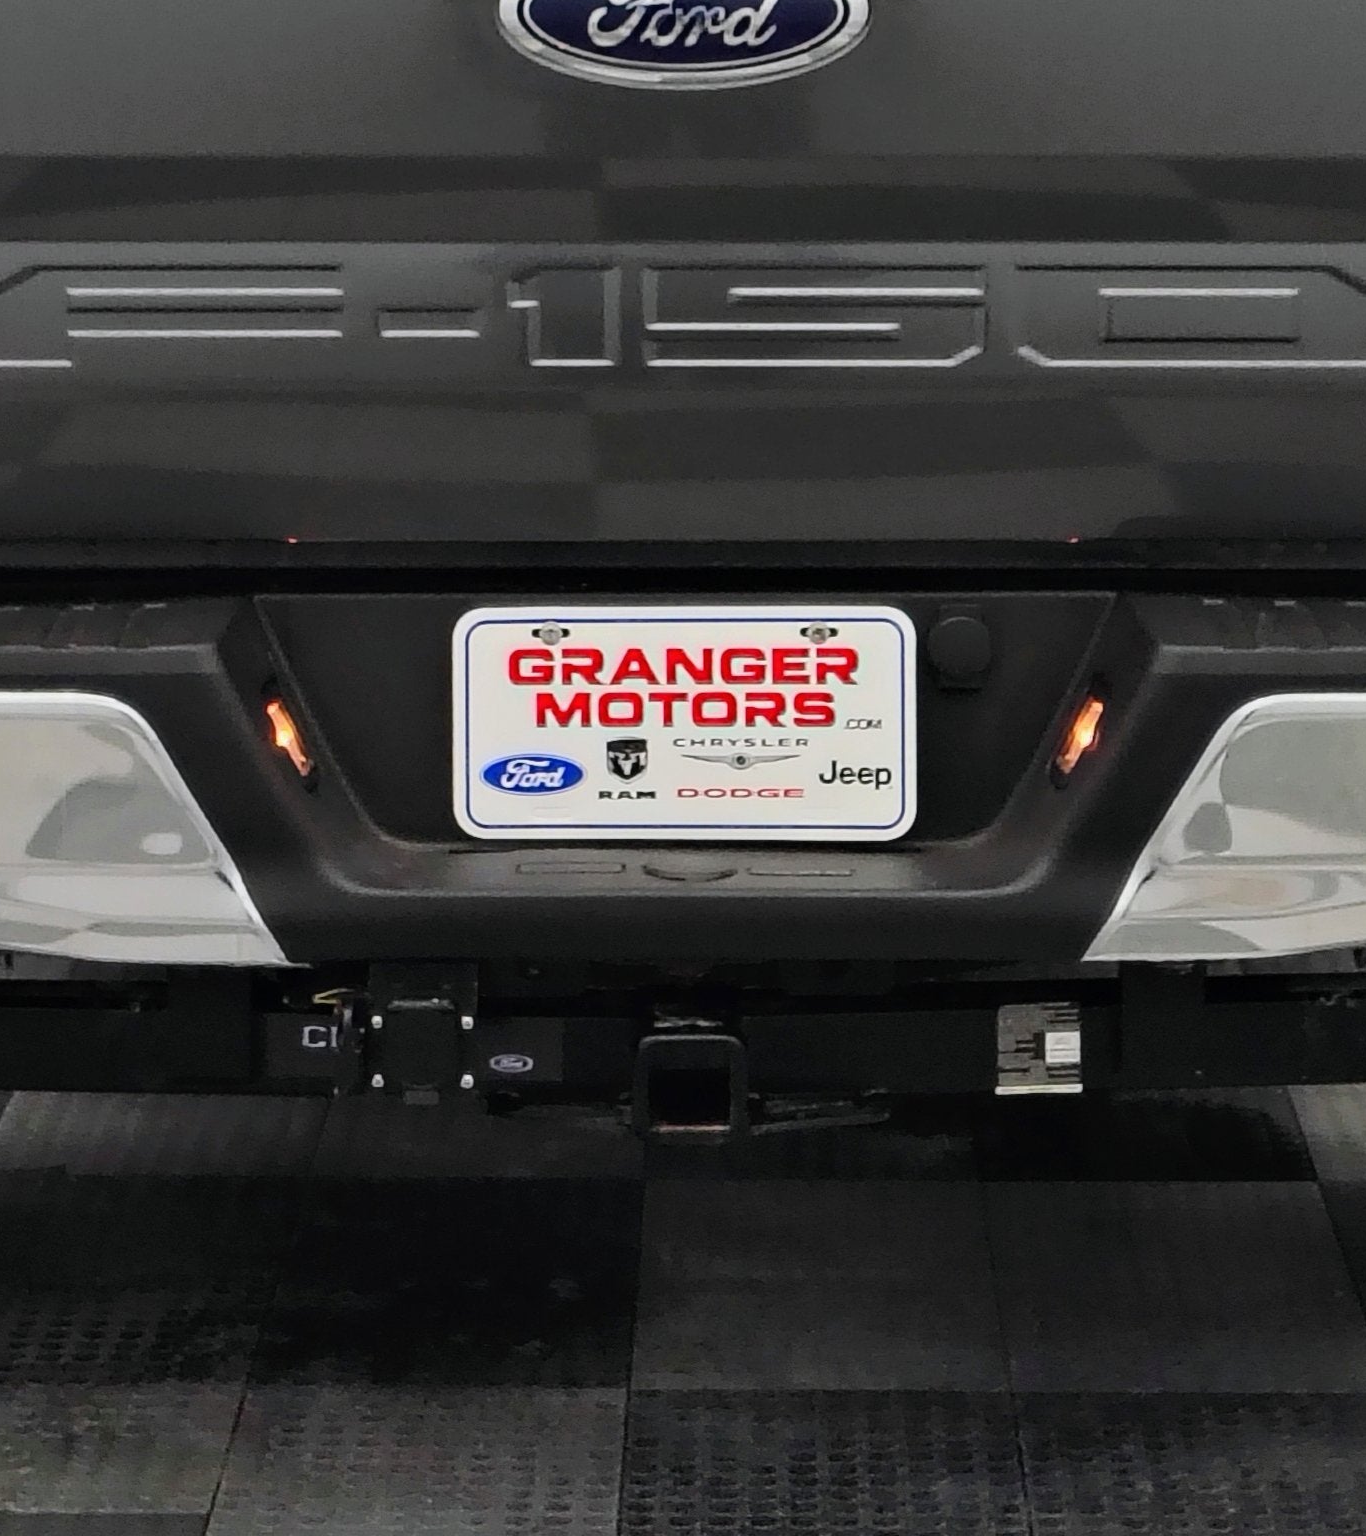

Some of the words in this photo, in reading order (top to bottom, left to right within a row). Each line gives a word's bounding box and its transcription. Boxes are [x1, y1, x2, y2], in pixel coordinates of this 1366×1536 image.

[508, 647, 860, 686] GRANGER
[535, 691, 836, 728] MOTORS
[672, 737, 810, 748] CHRYSLER
[500, 759, 566, 789] Ford
[818, 759, 892, 790] Jeep
[598, 790, 657, 800] RAM
[676, 787, 806, 799] DODGE
